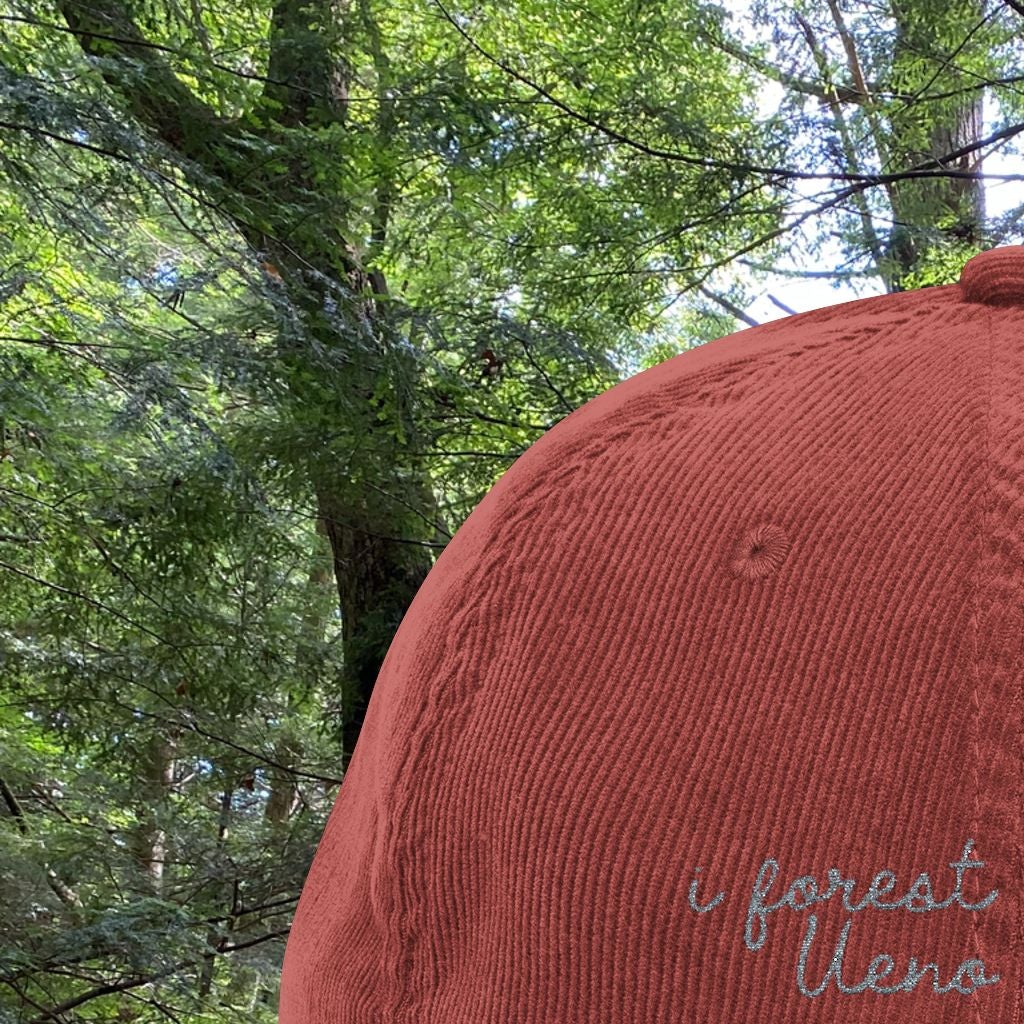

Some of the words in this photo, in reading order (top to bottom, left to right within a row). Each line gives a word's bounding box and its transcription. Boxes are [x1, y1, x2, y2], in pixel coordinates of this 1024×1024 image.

[688, 867, 724, 912] i
[744, 840, 997, 951] forest
[797, 914, 999, 997] Ueno
